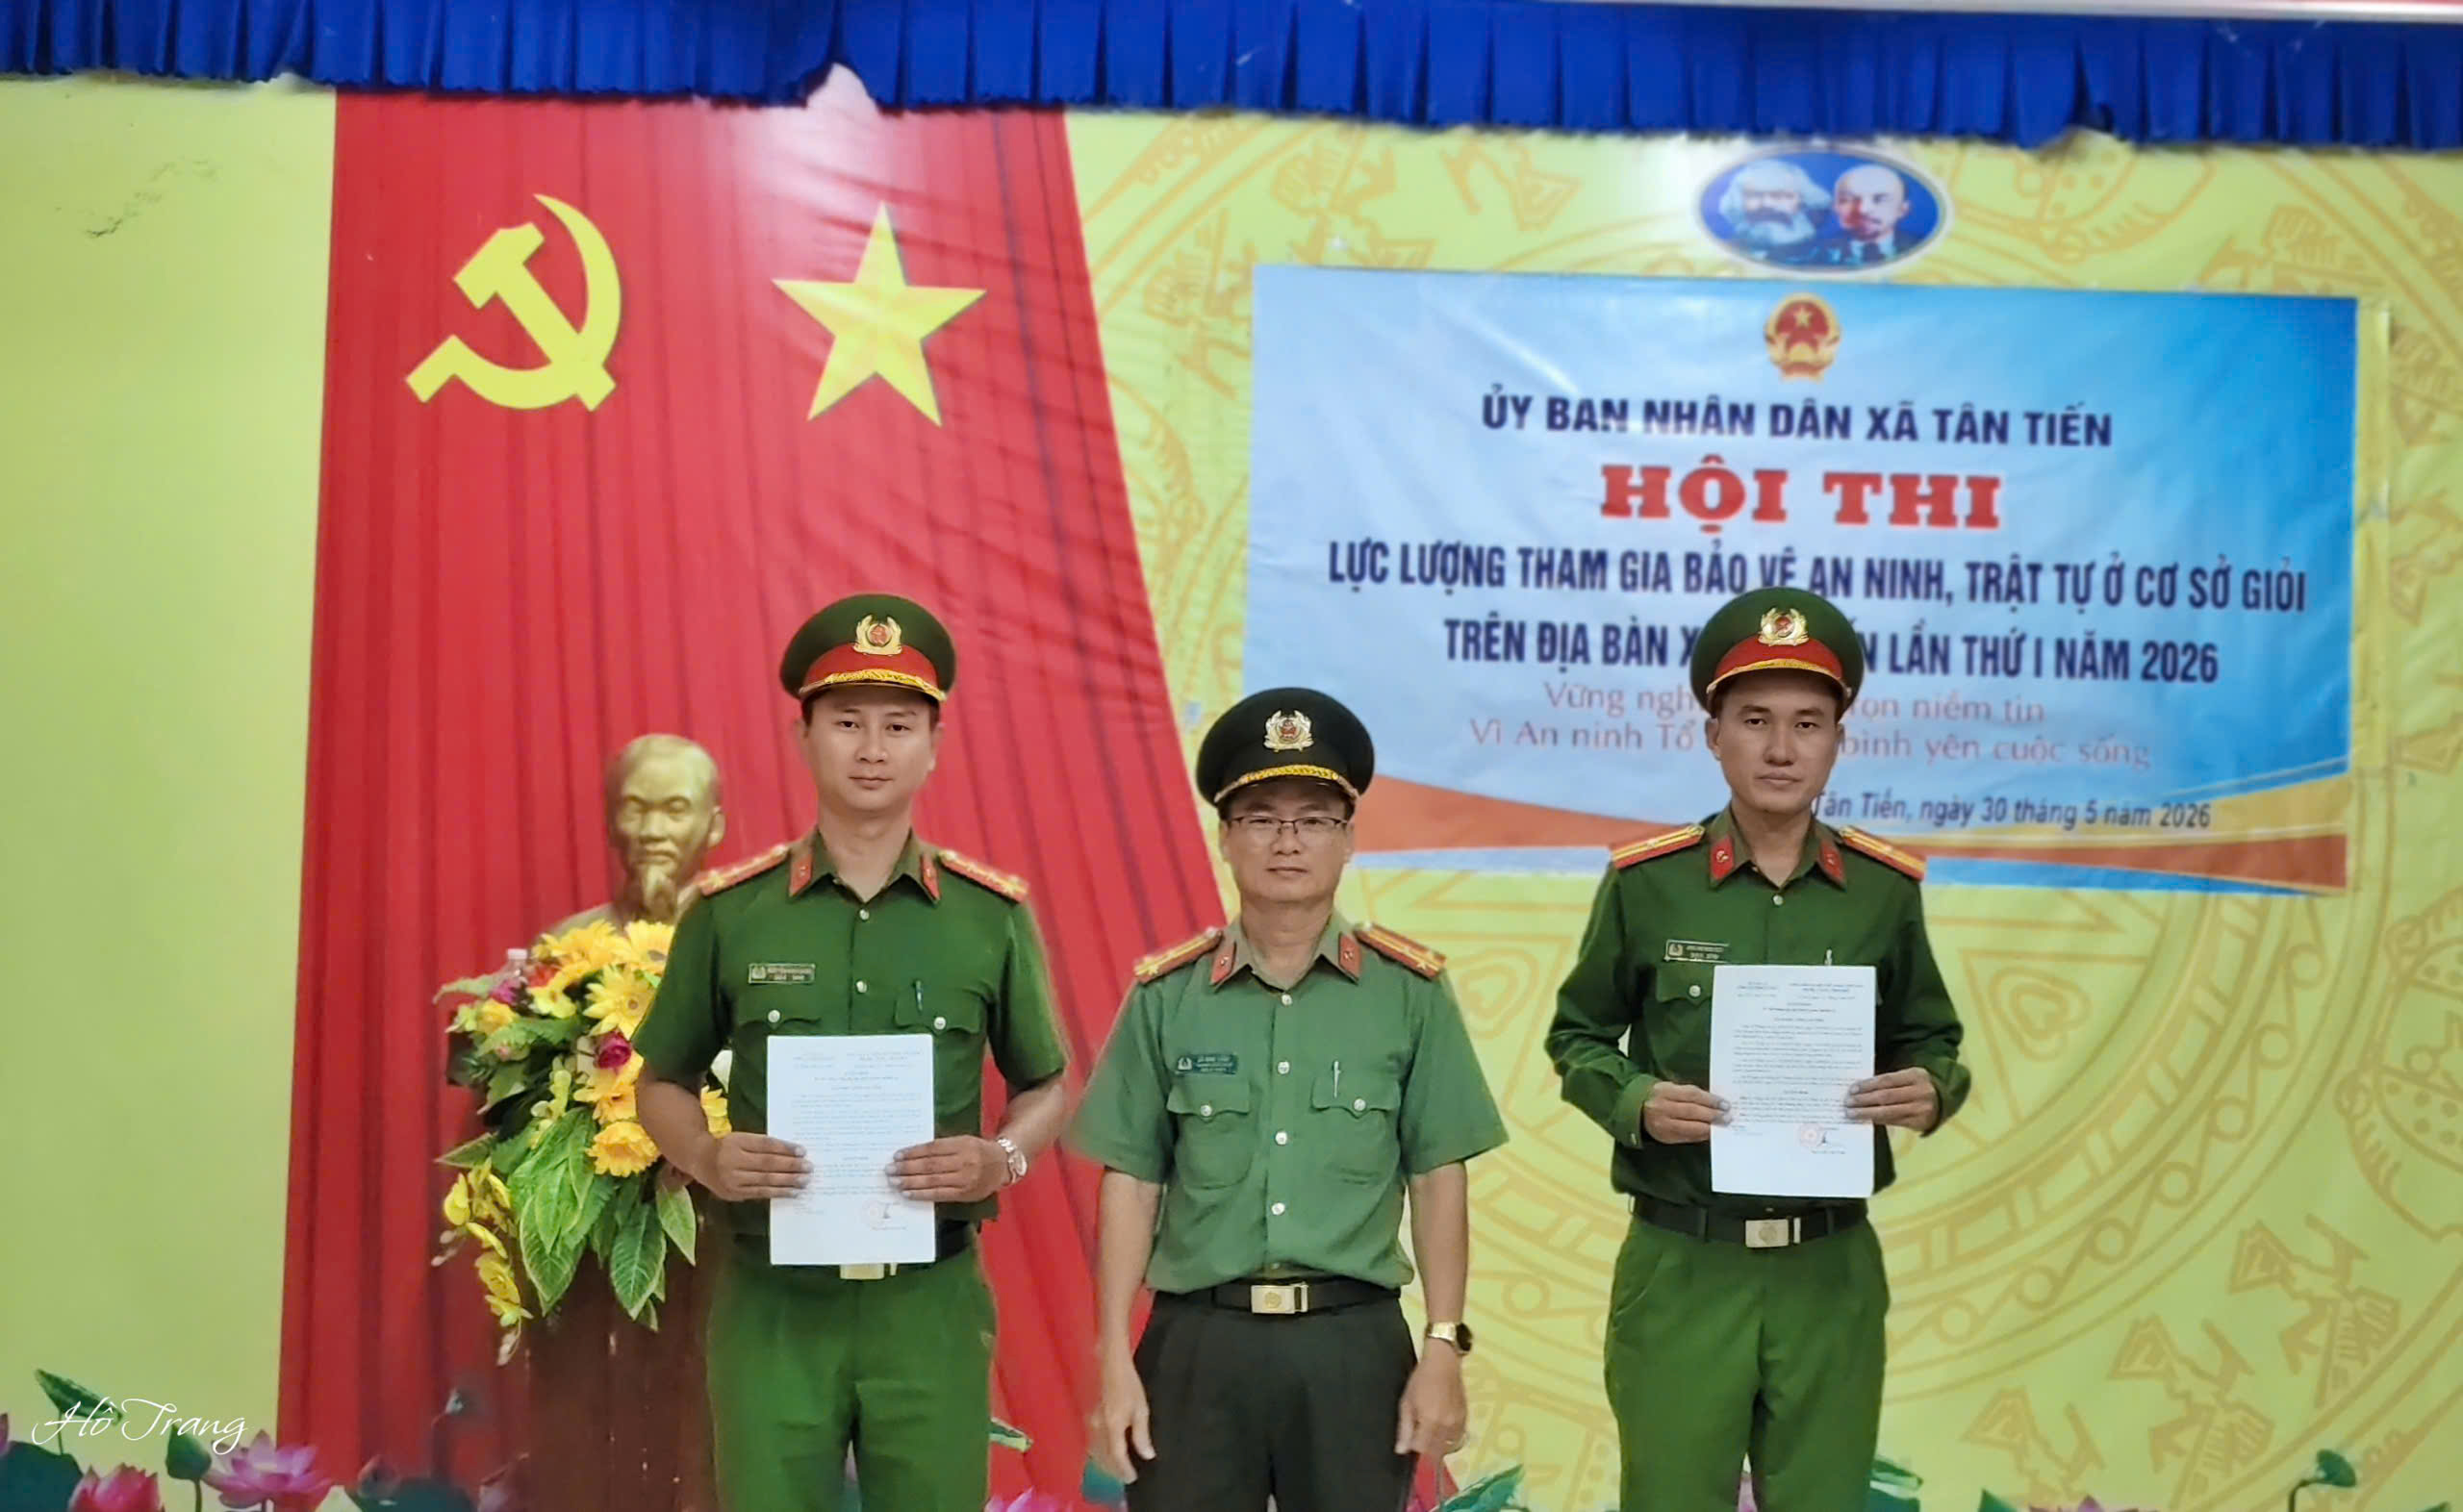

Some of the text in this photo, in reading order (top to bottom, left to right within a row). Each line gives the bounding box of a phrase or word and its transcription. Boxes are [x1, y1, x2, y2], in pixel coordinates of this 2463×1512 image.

[1483, 383, 2112, 446] ỦY BAN NHÂN DÂN XÃ TÂN TIẾN
[1600, 453, 2001, 534] HỘI THI
[1329, 537, 1389, 593] LỰC
[1400, 540, 1506, 595] LƯỢNG
[1517, 546, 1609, 591] THAM
[1620, 551, 1672, 593] GIA
[1685, 539, 1747, 594] BẢO
[1809, 556, 1853, 598] AN
[1864, 558, 1954, 607] NINH,
[1965, 552, 2044, 614] TRẬT
[2053, 560, 2096, 615] TỰ
[2103, 550, 2125, 607] Ở
[2136, 562, 2180, 608] CƠ
[2188, 553, 2232, 609] SỞ
[2242, 556, 2306, 613] GIỎI
[1444, 610, 1526, 662] TRÊN
[1536, 620, 1591, 673] ĐỊA
[1601, 615, 1669, 668] BÀN
[1679, 626, 1701, 668] X
[1962, 626, 2026, 678] THỨ
[2033, 636, 2043, 678] I
[2054, 629, 2130, 681] NĂM
[2141, 639, 2219, 684] 2026
[1544, 681, 1626, 718] Vững
[1638, 683, 1695, 720] ngh
[1848, 698, 1900, 721] rọn
[2004, 694, 2044, 723] tin
[1469, 718, 1502, 745] Vì
[1515, 720, 1559, 746] An
[1571, 721, 1643, 748] ninh
[1656, 718, 1696, 750] Tổ
[1925, 732, 1979, 768] yên
[1993, 734, 2064, 766] cuộc
[2077, 733, 2151, 773] sống
[1920, 793, 1976, 828] ngày
[1982, 795, 2008, 822] 30
[2014, 795, 2078, 831] tháng
[2085, 799, 2098, 824] 5
[2104, 801, 2152, 826] năm
[2159, 801, 2212, 828] 2026
